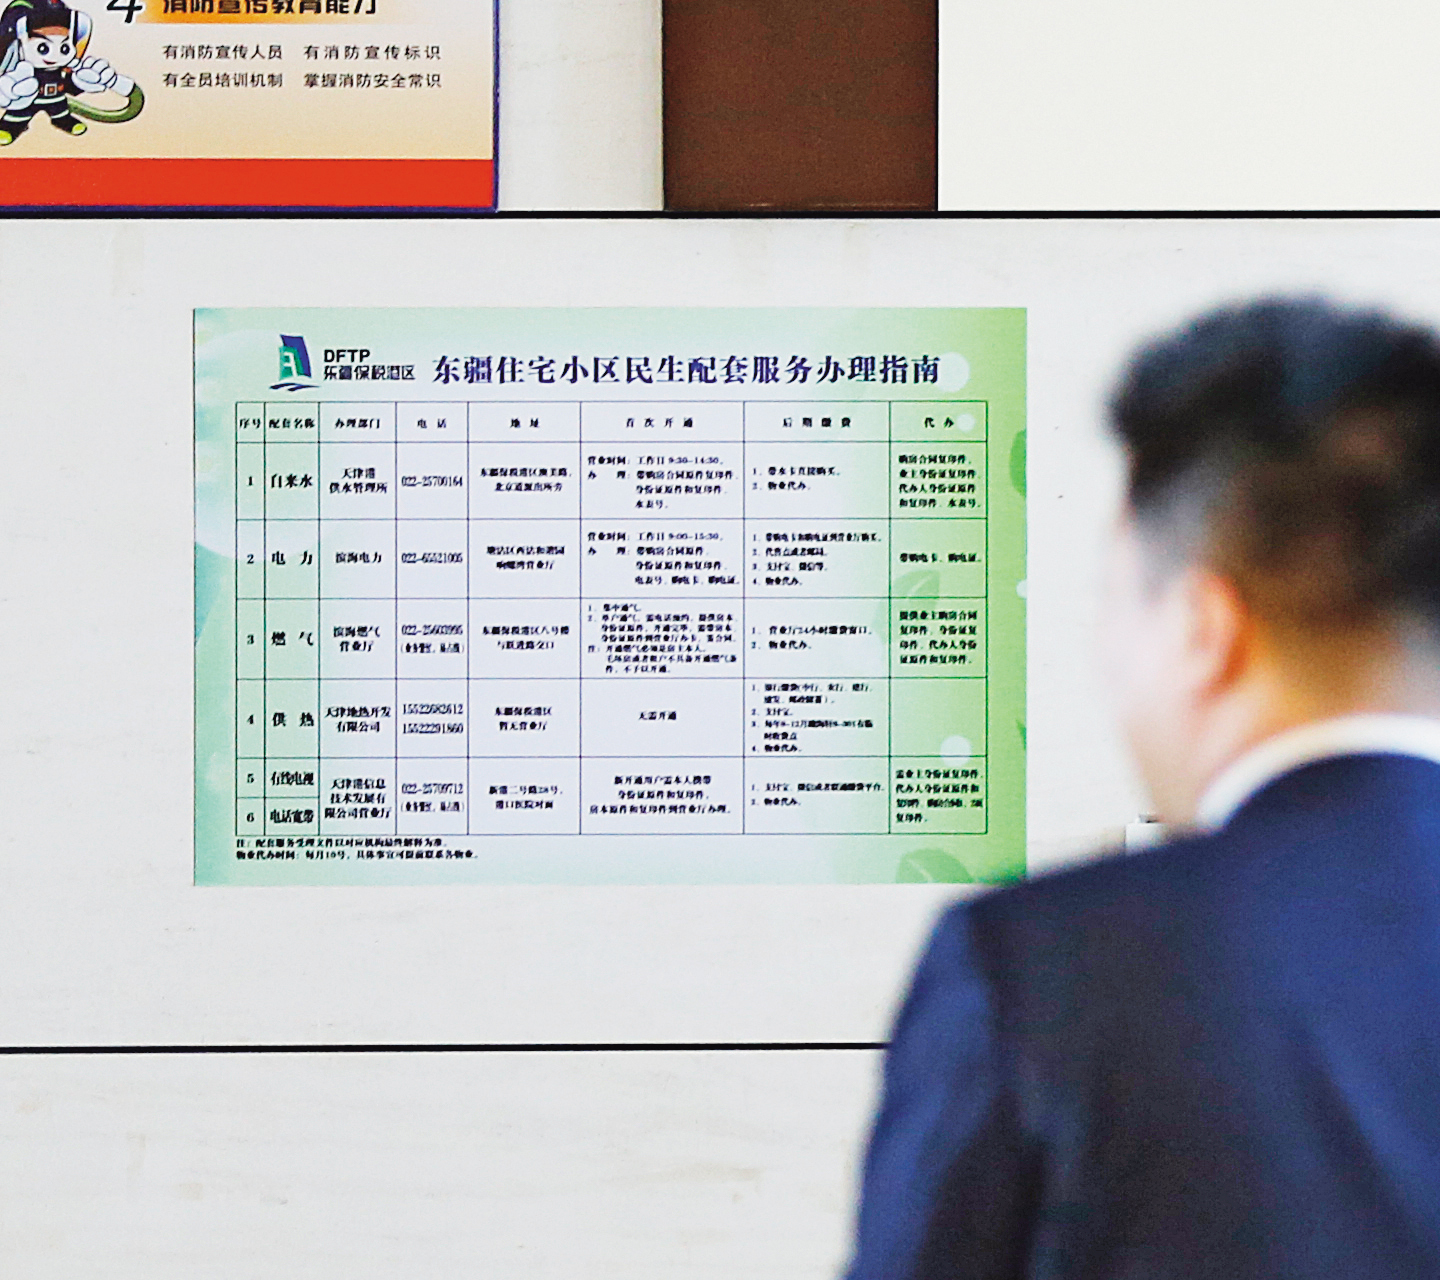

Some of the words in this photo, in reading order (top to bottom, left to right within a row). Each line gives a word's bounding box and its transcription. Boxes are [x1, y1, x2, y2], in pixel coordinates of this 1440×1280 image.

[163, 45, 283, 61] 有消防宣传人员
[163, 73, 284, 89] 有全员培训机制
[303, 73, 442, 89] 掌握消防安全常识
[324, 349, 370, 363] DFTP
[324, 365, 415, 381] 东疆保税港区
[432, 355, 941, 384] 东疆住宅小区民生配套服务办理指南
[248, 476, 253, 486] 1
[271, 473, 313, 489] 自来水
[247, 554, 254, 564] 2
[272, 550, 312, 565] 电力
[247, 634, 254, 644] 3
[271, 631, 314, 646] 燃气
[247, 714, 254, 724] 4
[272, 712, 314, 727] 供热
[247, 773, 254, 783] 5
[247, 812, 254, 822] 6
